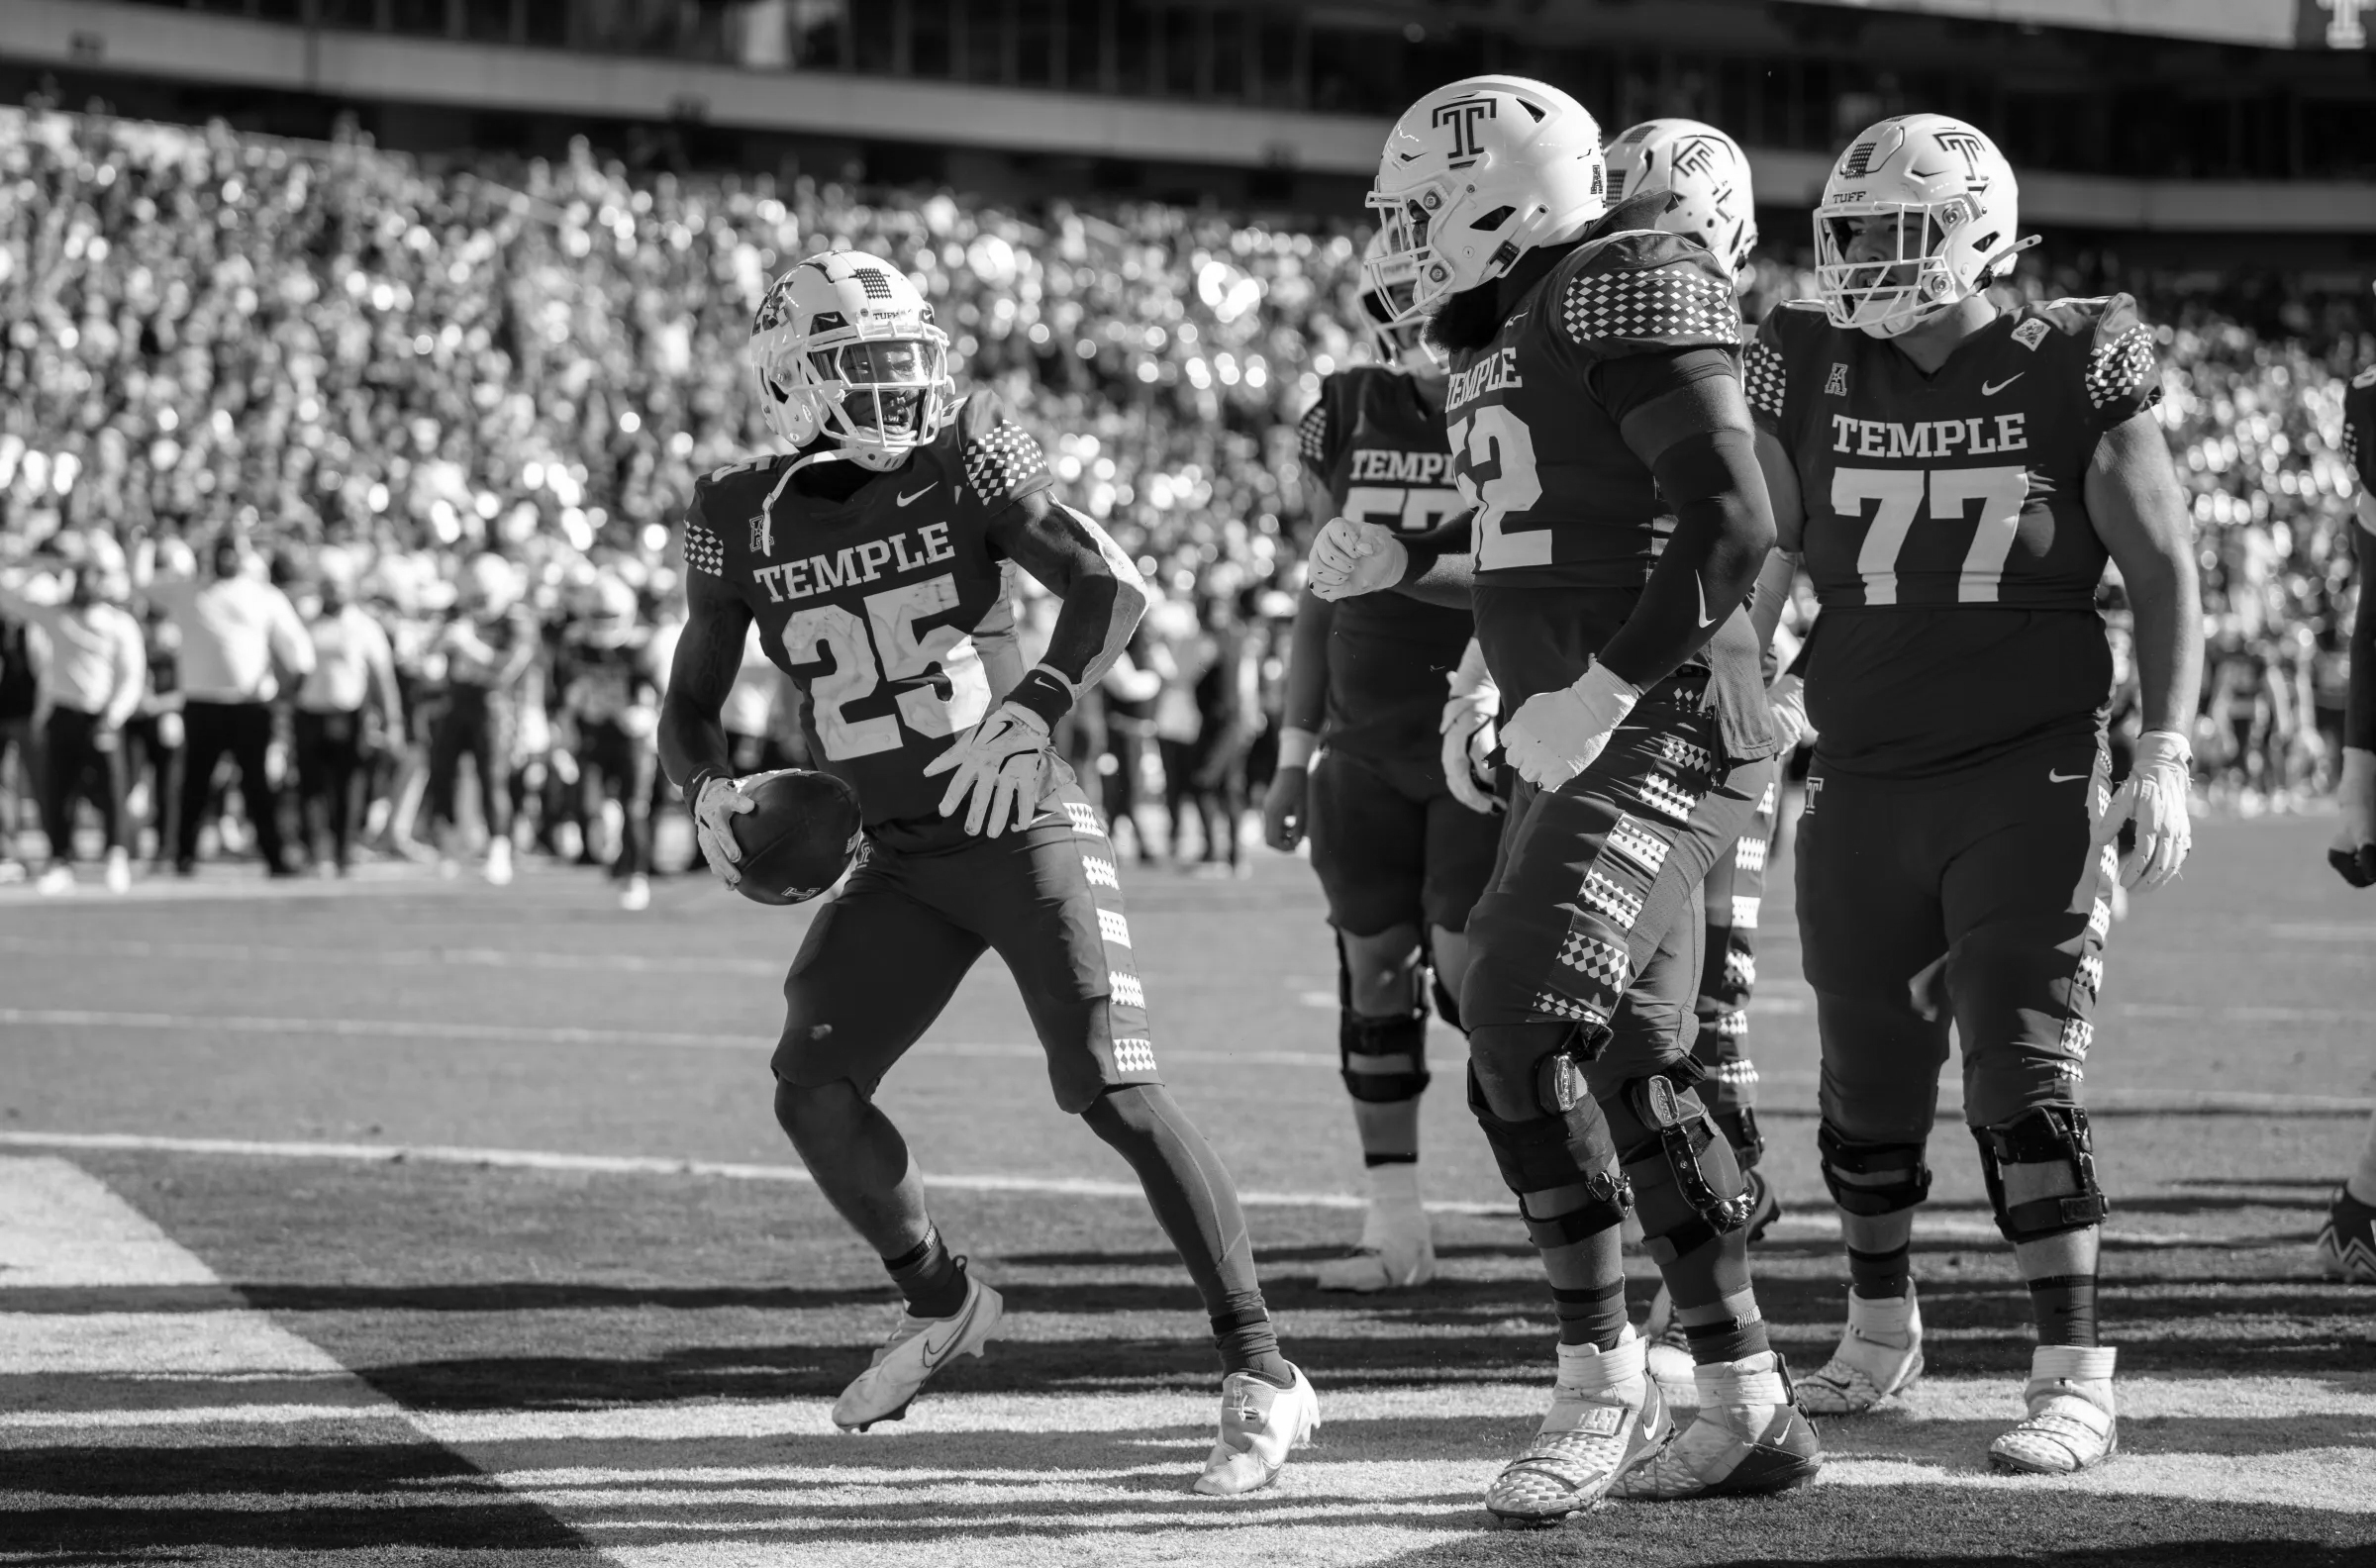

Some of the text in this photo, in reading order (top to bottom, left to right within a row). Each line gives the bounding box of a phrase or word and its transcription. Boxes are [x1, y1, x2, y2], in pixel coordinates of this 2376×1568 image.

[1832, 190, 1867, 204] TUFF
[1444, 346, 1524, 414] TEMPLE
[1831, 412, 2029, 458] TEMPLE
[1348, 448, 1457, 485] TEMPL
[752, 521, 956, 605] TEMPLE
[1831, 464, 2030, 606] 77
[780, 572, 993, 762] 25
[1804, 776, 1825, 815] T
